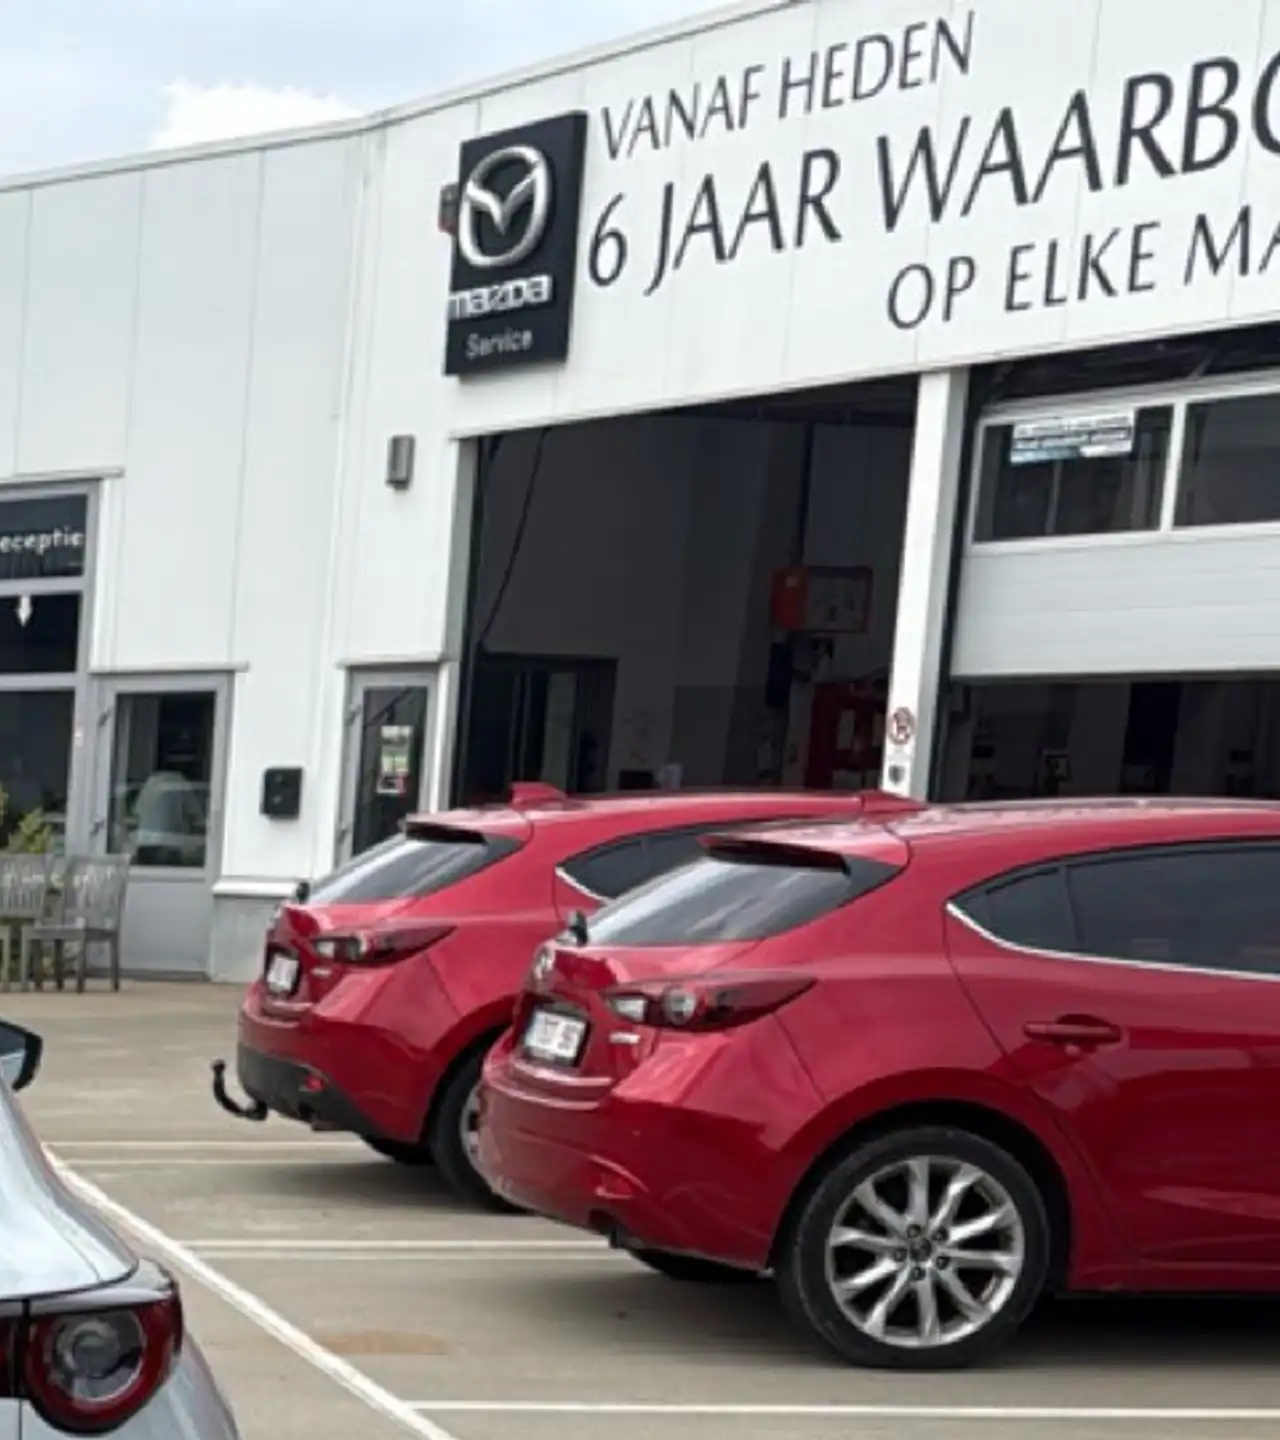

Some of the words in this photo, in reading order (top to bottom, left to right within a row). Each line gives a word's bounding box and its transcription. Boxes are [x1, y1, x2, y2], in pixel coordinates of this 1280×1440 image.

[601, 64, 765, 160] VANAF
[778, 10, 974, 119] HEDEN
[588, 192, 628, 287] 6
[643, 148, 842, 297] JAAR
[887, 255, 977, 330] OP
[1004, 220, 1161, 312] ELKE
[466, 329, 533, 361] Service
